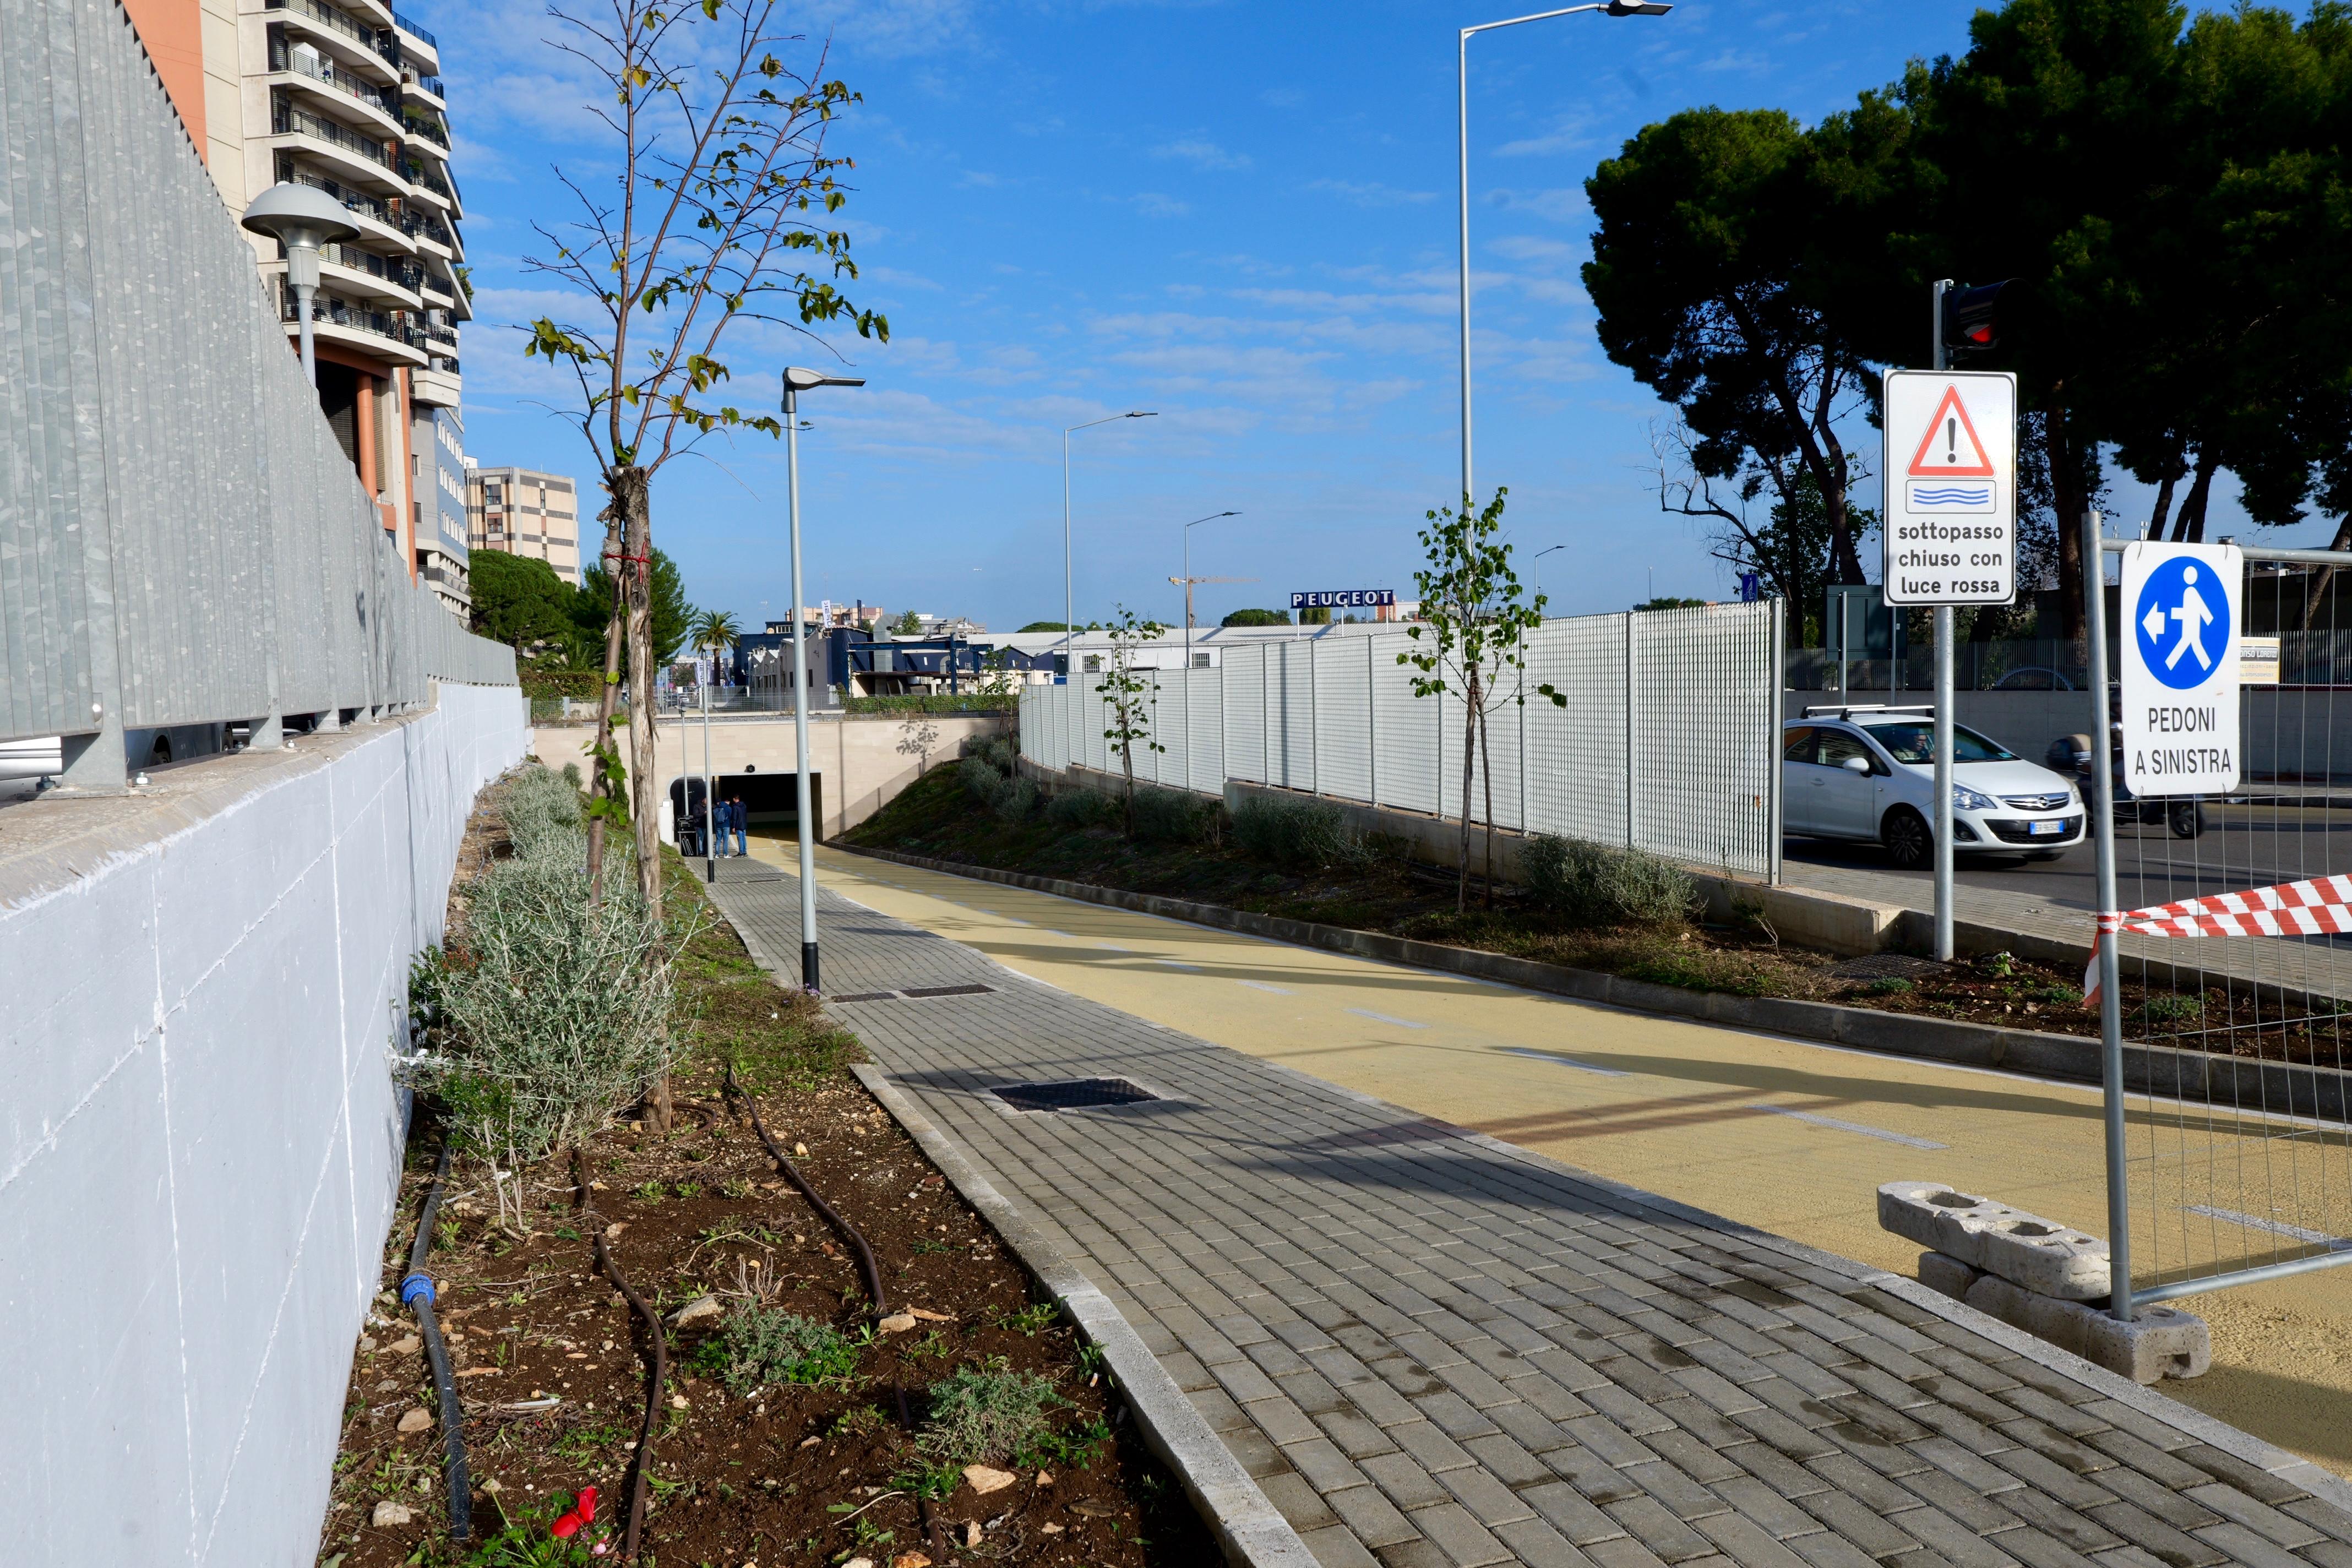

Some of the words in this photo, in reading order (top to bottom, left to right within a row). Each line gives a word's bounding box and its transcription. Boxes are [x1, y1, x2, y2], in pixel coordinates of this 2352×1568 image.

[1898, 522, 2003, 543] sottopasso
[1898, 549, 1961, 567] chiuso
[1970, 553, 2002, 566] con
[1901, 576, 1941, 594] luce
[1951, 580, 2000, 593] rossa
[1293, 591, 1391, 606] PEUGEOT
[2148, 707, 2215, 732] PEDONI
[2135, 750, 2146, 775] A
[2152, 748, 2231, 775] SINISTRA
